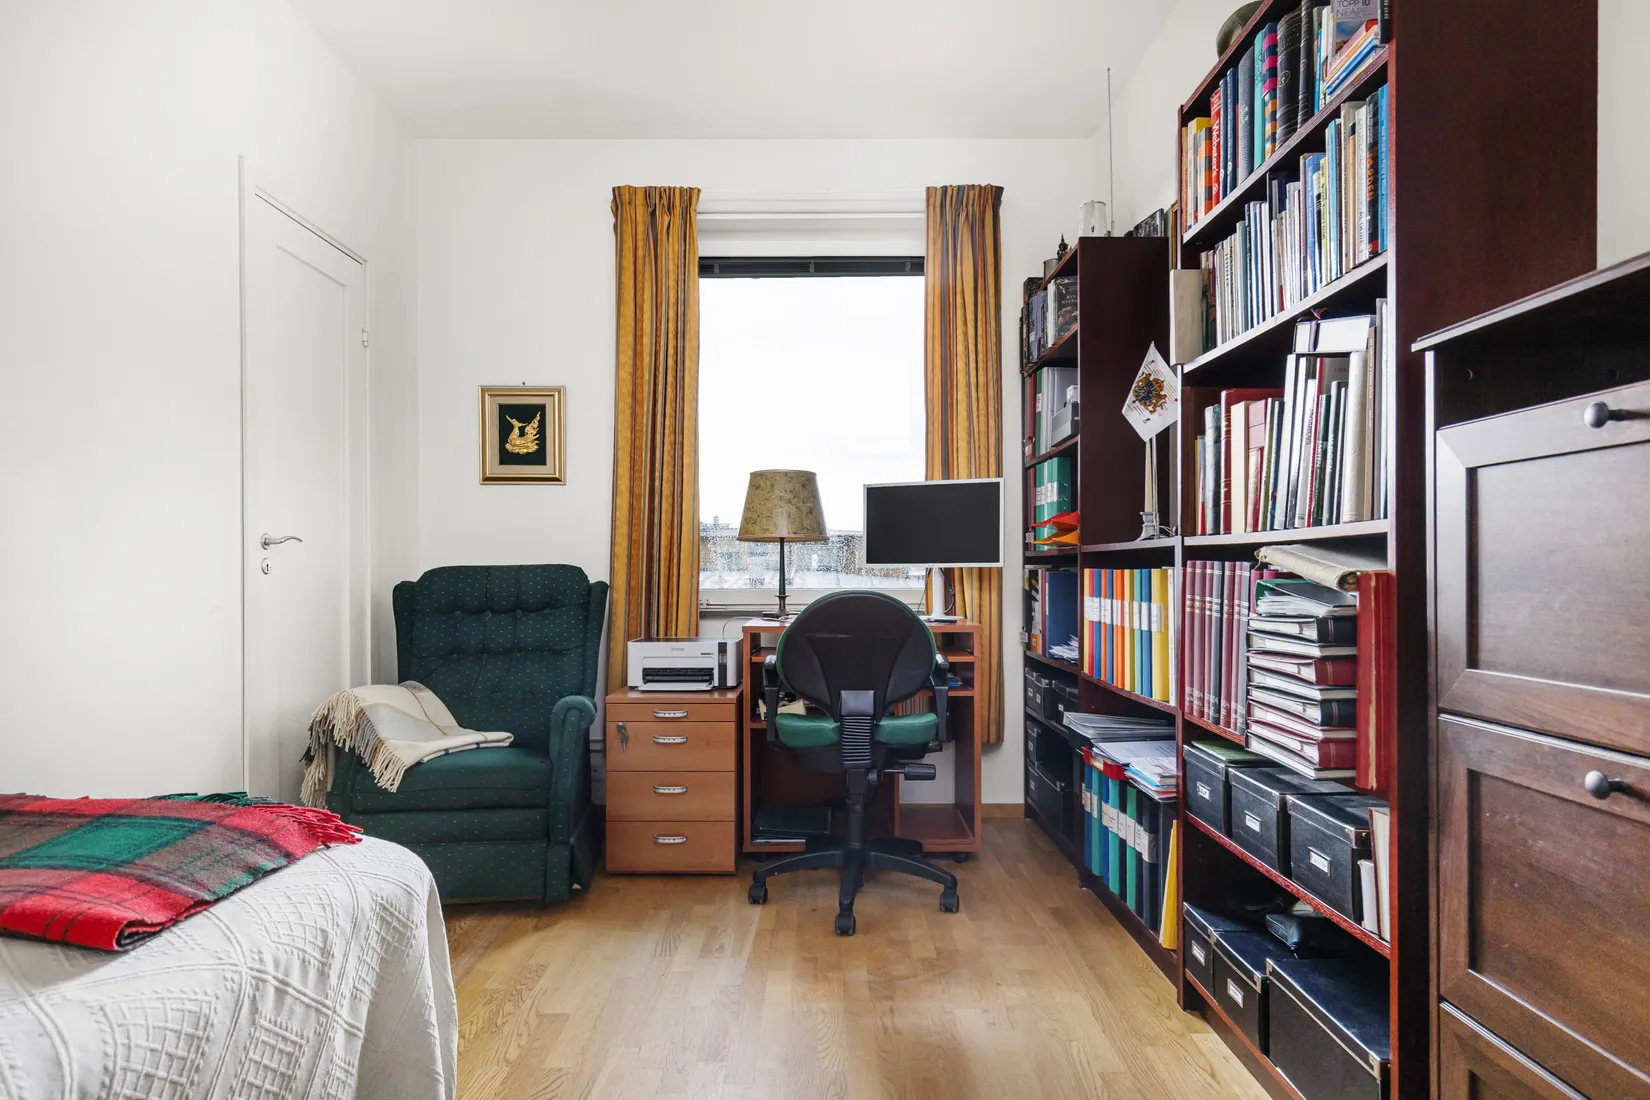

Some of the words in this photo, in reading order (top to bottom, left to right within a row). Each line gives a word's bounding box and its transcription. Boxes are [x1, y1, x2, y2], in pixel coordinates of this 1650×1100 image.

[1337, 0, 1359, 8] TOPP
[1336, 7, 1373, 17] NEAPEL
[1211, 119, 1220, 180] Webster's
